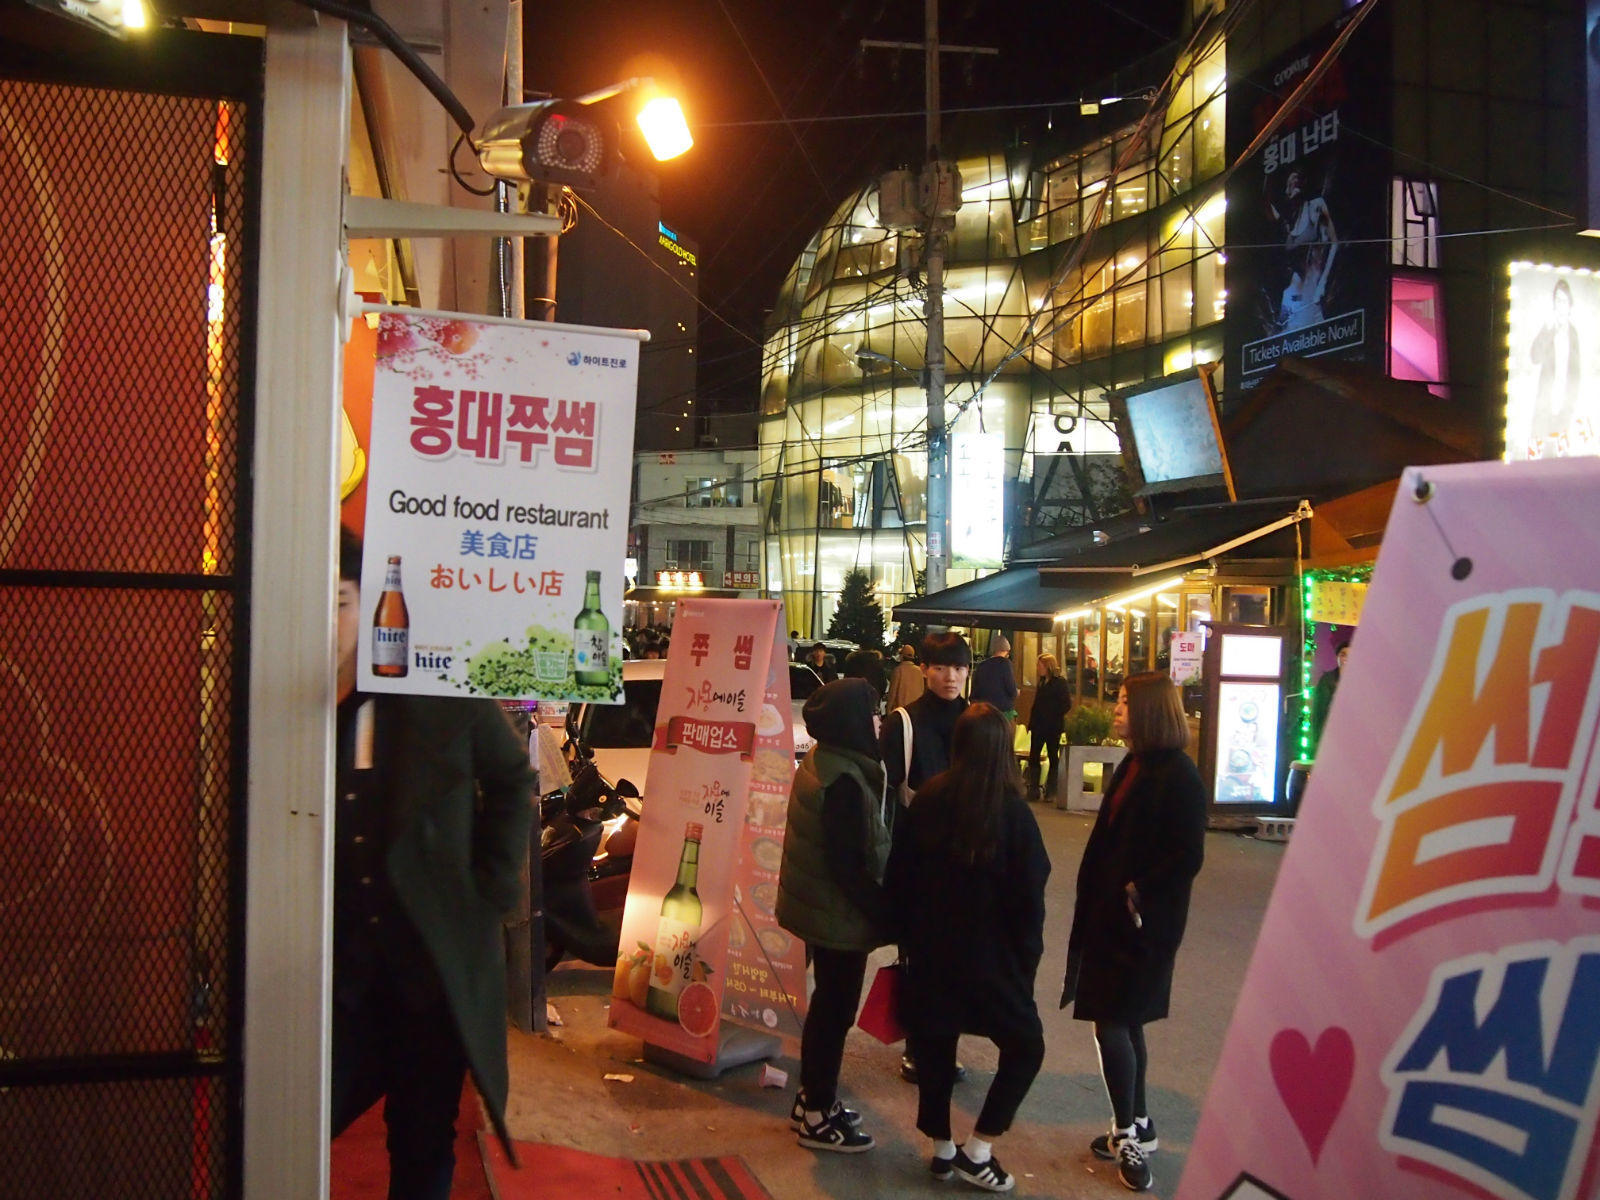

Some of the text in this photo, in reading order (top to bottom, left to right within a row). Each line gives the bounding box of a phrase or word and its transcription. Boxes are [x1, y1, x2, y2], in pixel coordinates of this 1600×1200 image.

[1302, 109, 1339, 155] 난타
[1249, 318, 1358, 365] Tickets Available Now!
[583, 355, 627, 368] 하이트진로
[389, 490, 609, 530] Good food restaurant
[460, 529, 538, 560] 美食店
[430, 563, 564, 597] おいしい店
[377, 628, 406, 643] hite
[415, 652, 452, 669] hite
[682, 722, 738, 749] 판매업소
[704, 799, 725, 823] 이슬
[674, 952, 692, 979] 이슬
